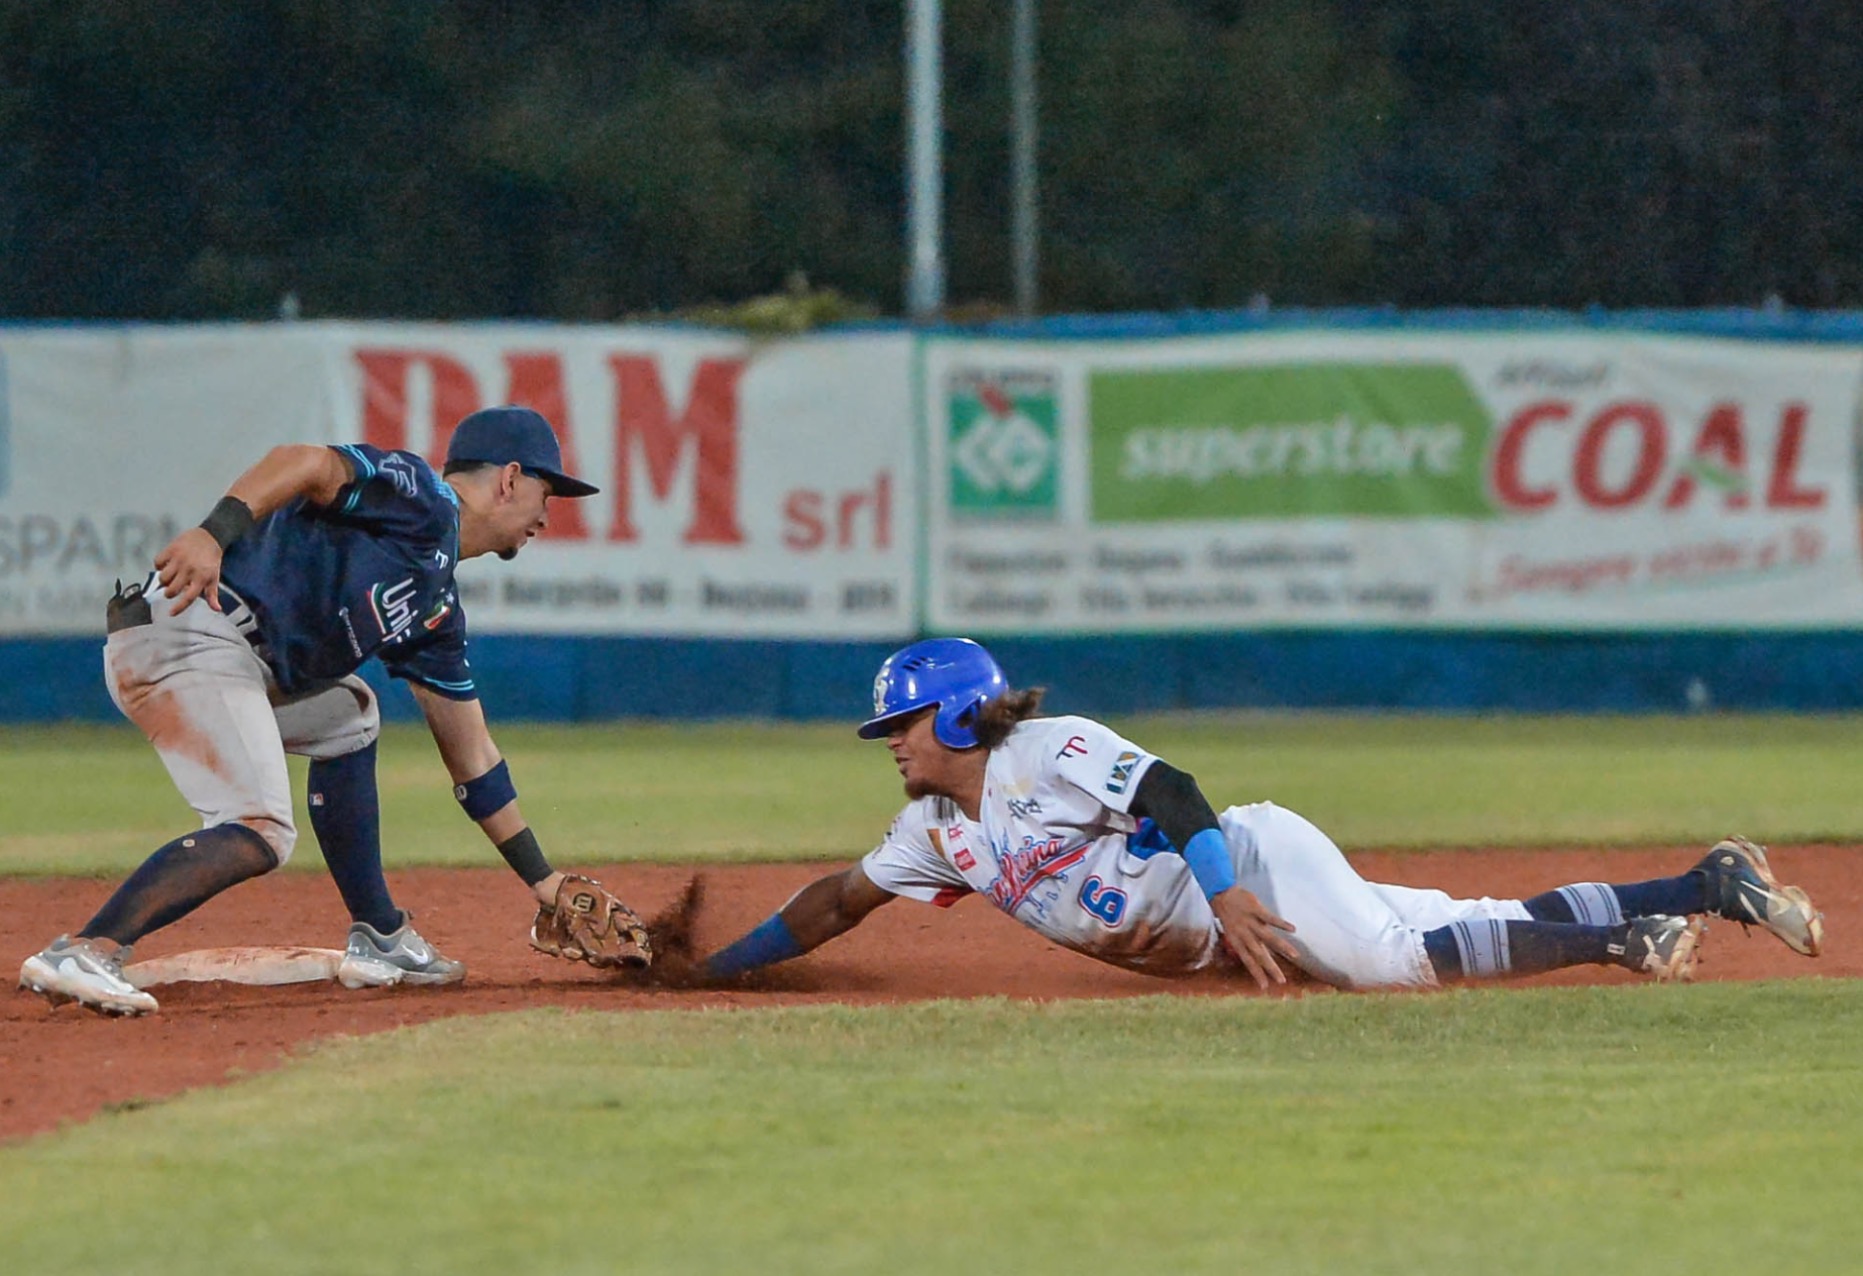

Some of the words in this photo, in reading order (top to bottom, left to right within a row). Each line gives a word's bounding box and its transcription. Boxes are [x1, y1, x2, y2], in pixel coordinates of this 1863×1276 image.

[353, 349, 747, 544] DAM
[1123, 418, 1462, 478] superstore
[1490, 401, 1827, 511] COAL
[783, 470, 892, 551] srl
[1079, 874, 1128, 928] 6
